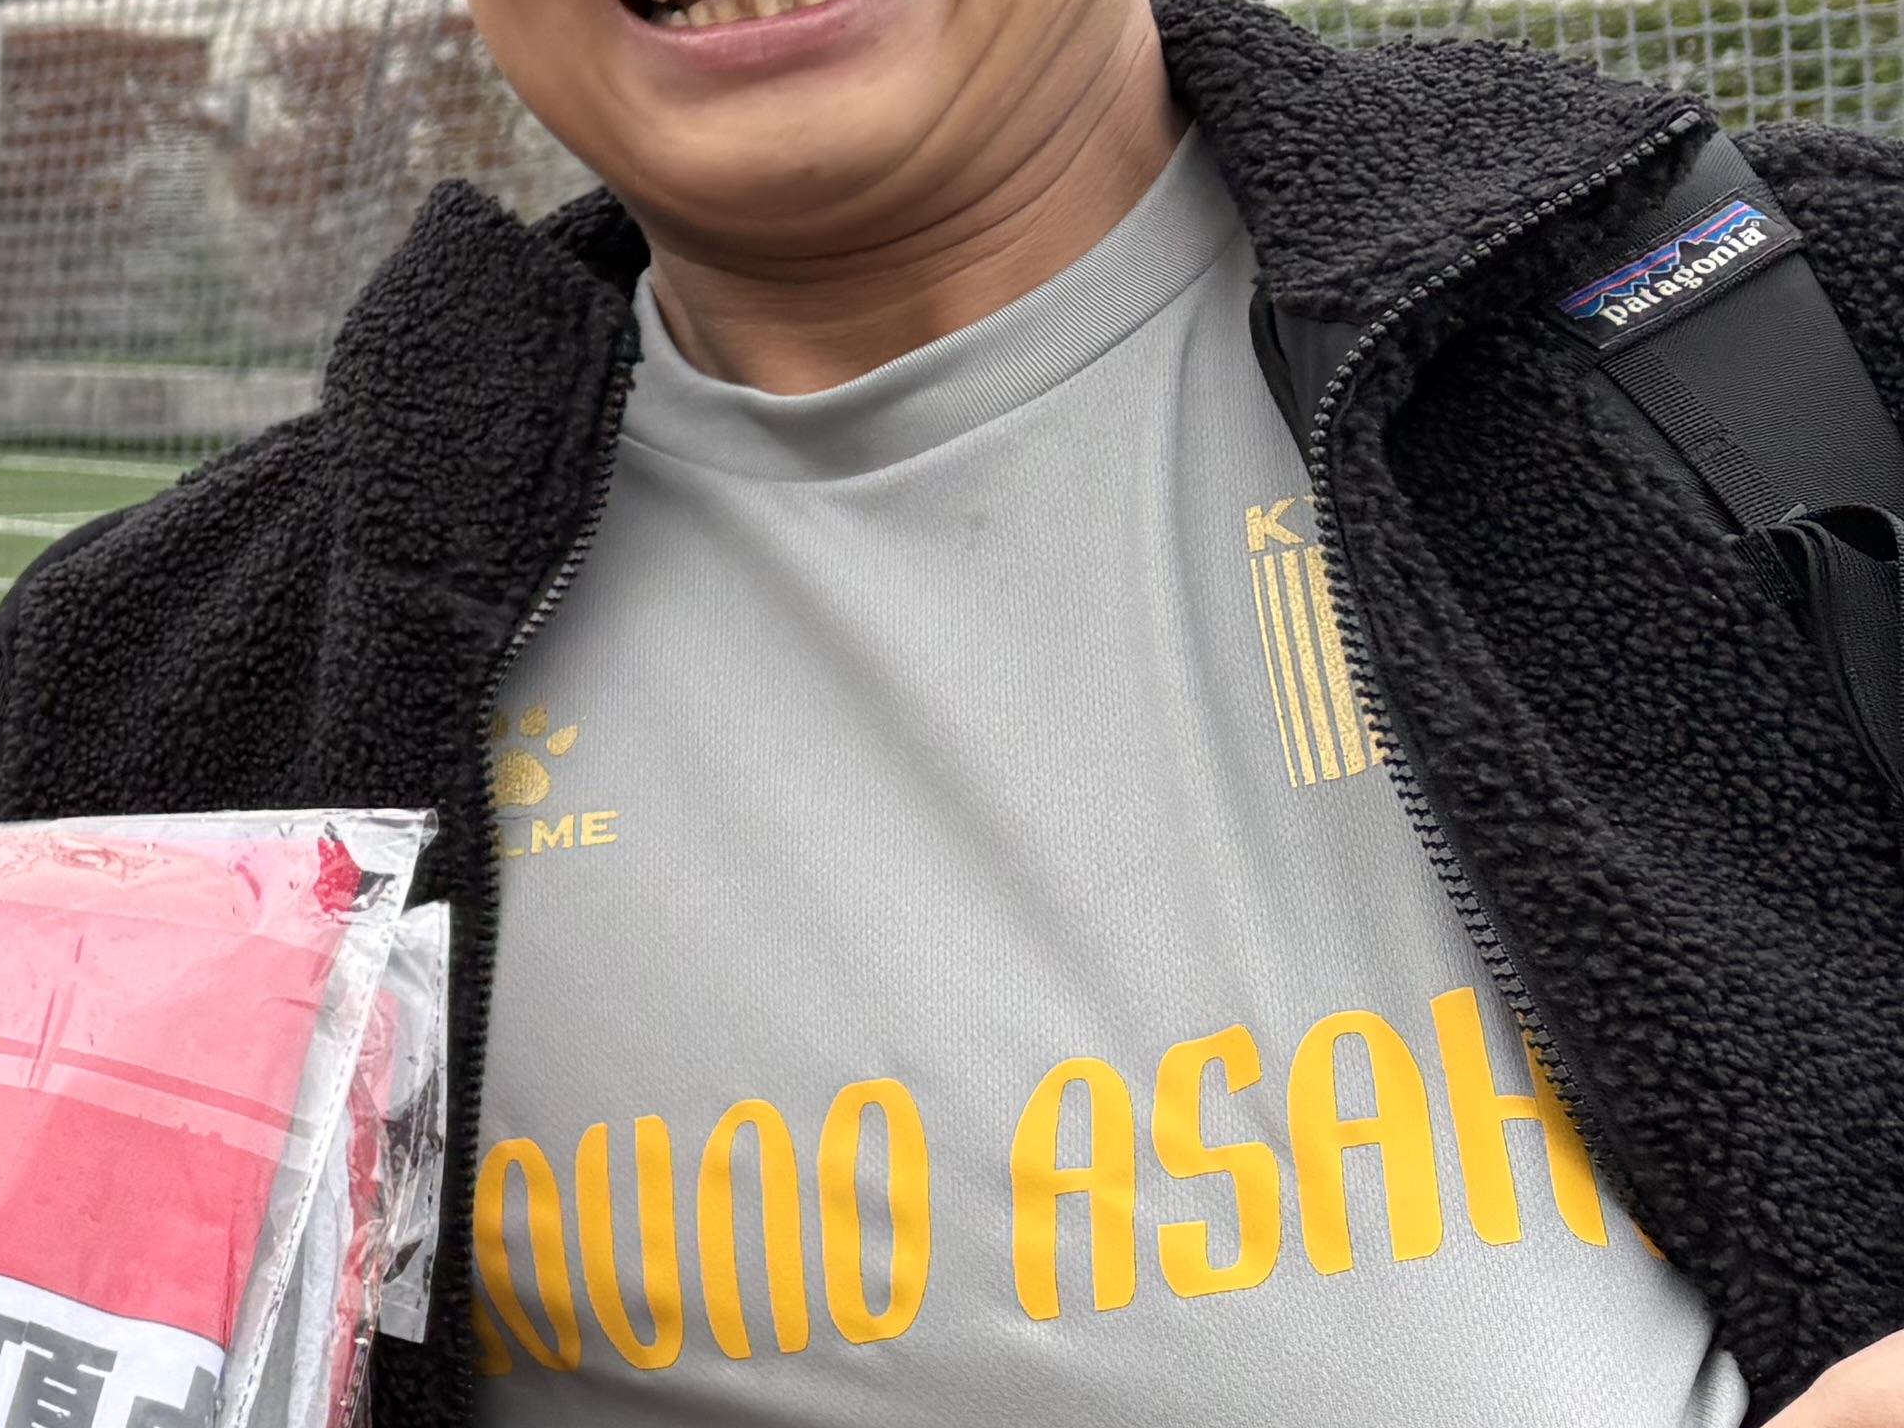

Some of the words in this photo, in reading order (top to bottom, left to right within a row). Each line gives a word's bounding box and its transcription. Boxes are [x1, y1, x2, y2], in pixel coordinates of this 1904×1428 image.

[1600, 222, 1767, 326] patagonia
[471, 1076, 931, 1376] OUNO
[1009, 986, 1667, 1321] ASAH
